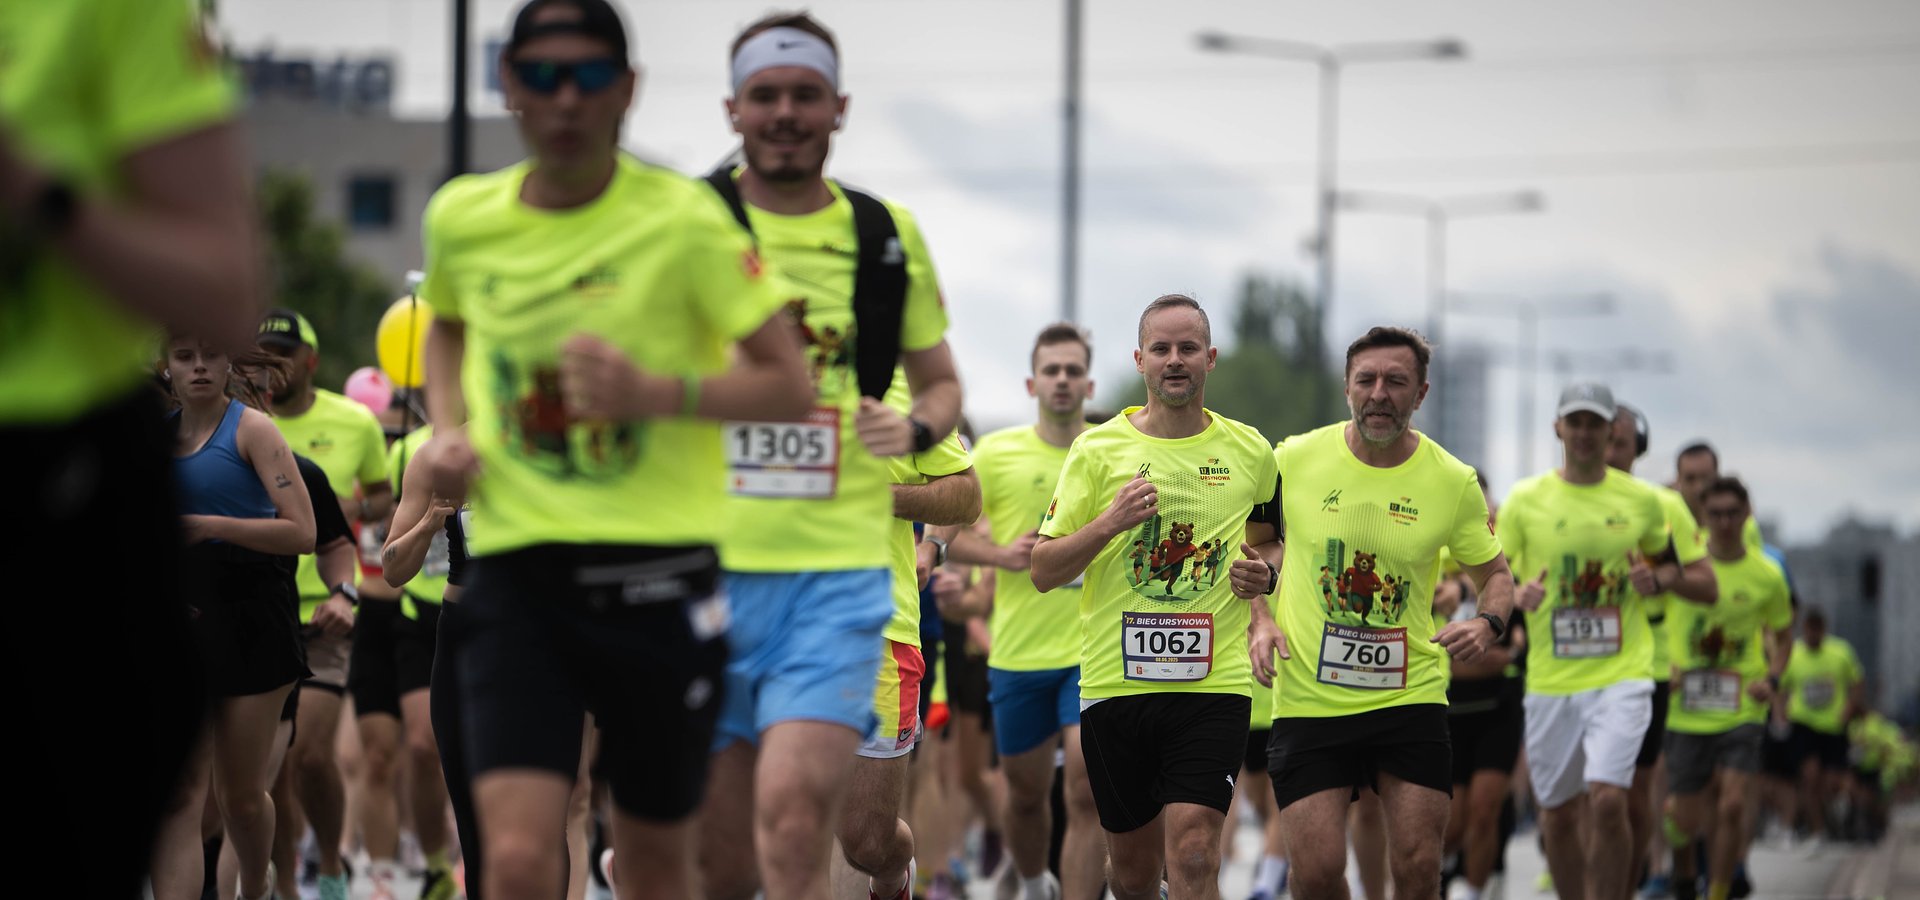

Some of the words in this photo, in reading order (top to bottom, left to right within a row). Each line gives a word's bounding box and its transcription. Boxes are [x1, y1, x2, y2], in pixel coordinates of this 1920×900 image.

[735, 426, 825, 461] 1305
[1401, 506, 1418, 515] BIEG
[1159, 618, 1210, 626] URSYNOWA
[1134, 631, 1201, 655] 1062
[1327, 625, 1337, 634] 17.
[1338, 629, 1358, 638] BIEG
[1360, 632, 1404, 641] URSYNOWA
[1342, 641, 1390, 666] 760
